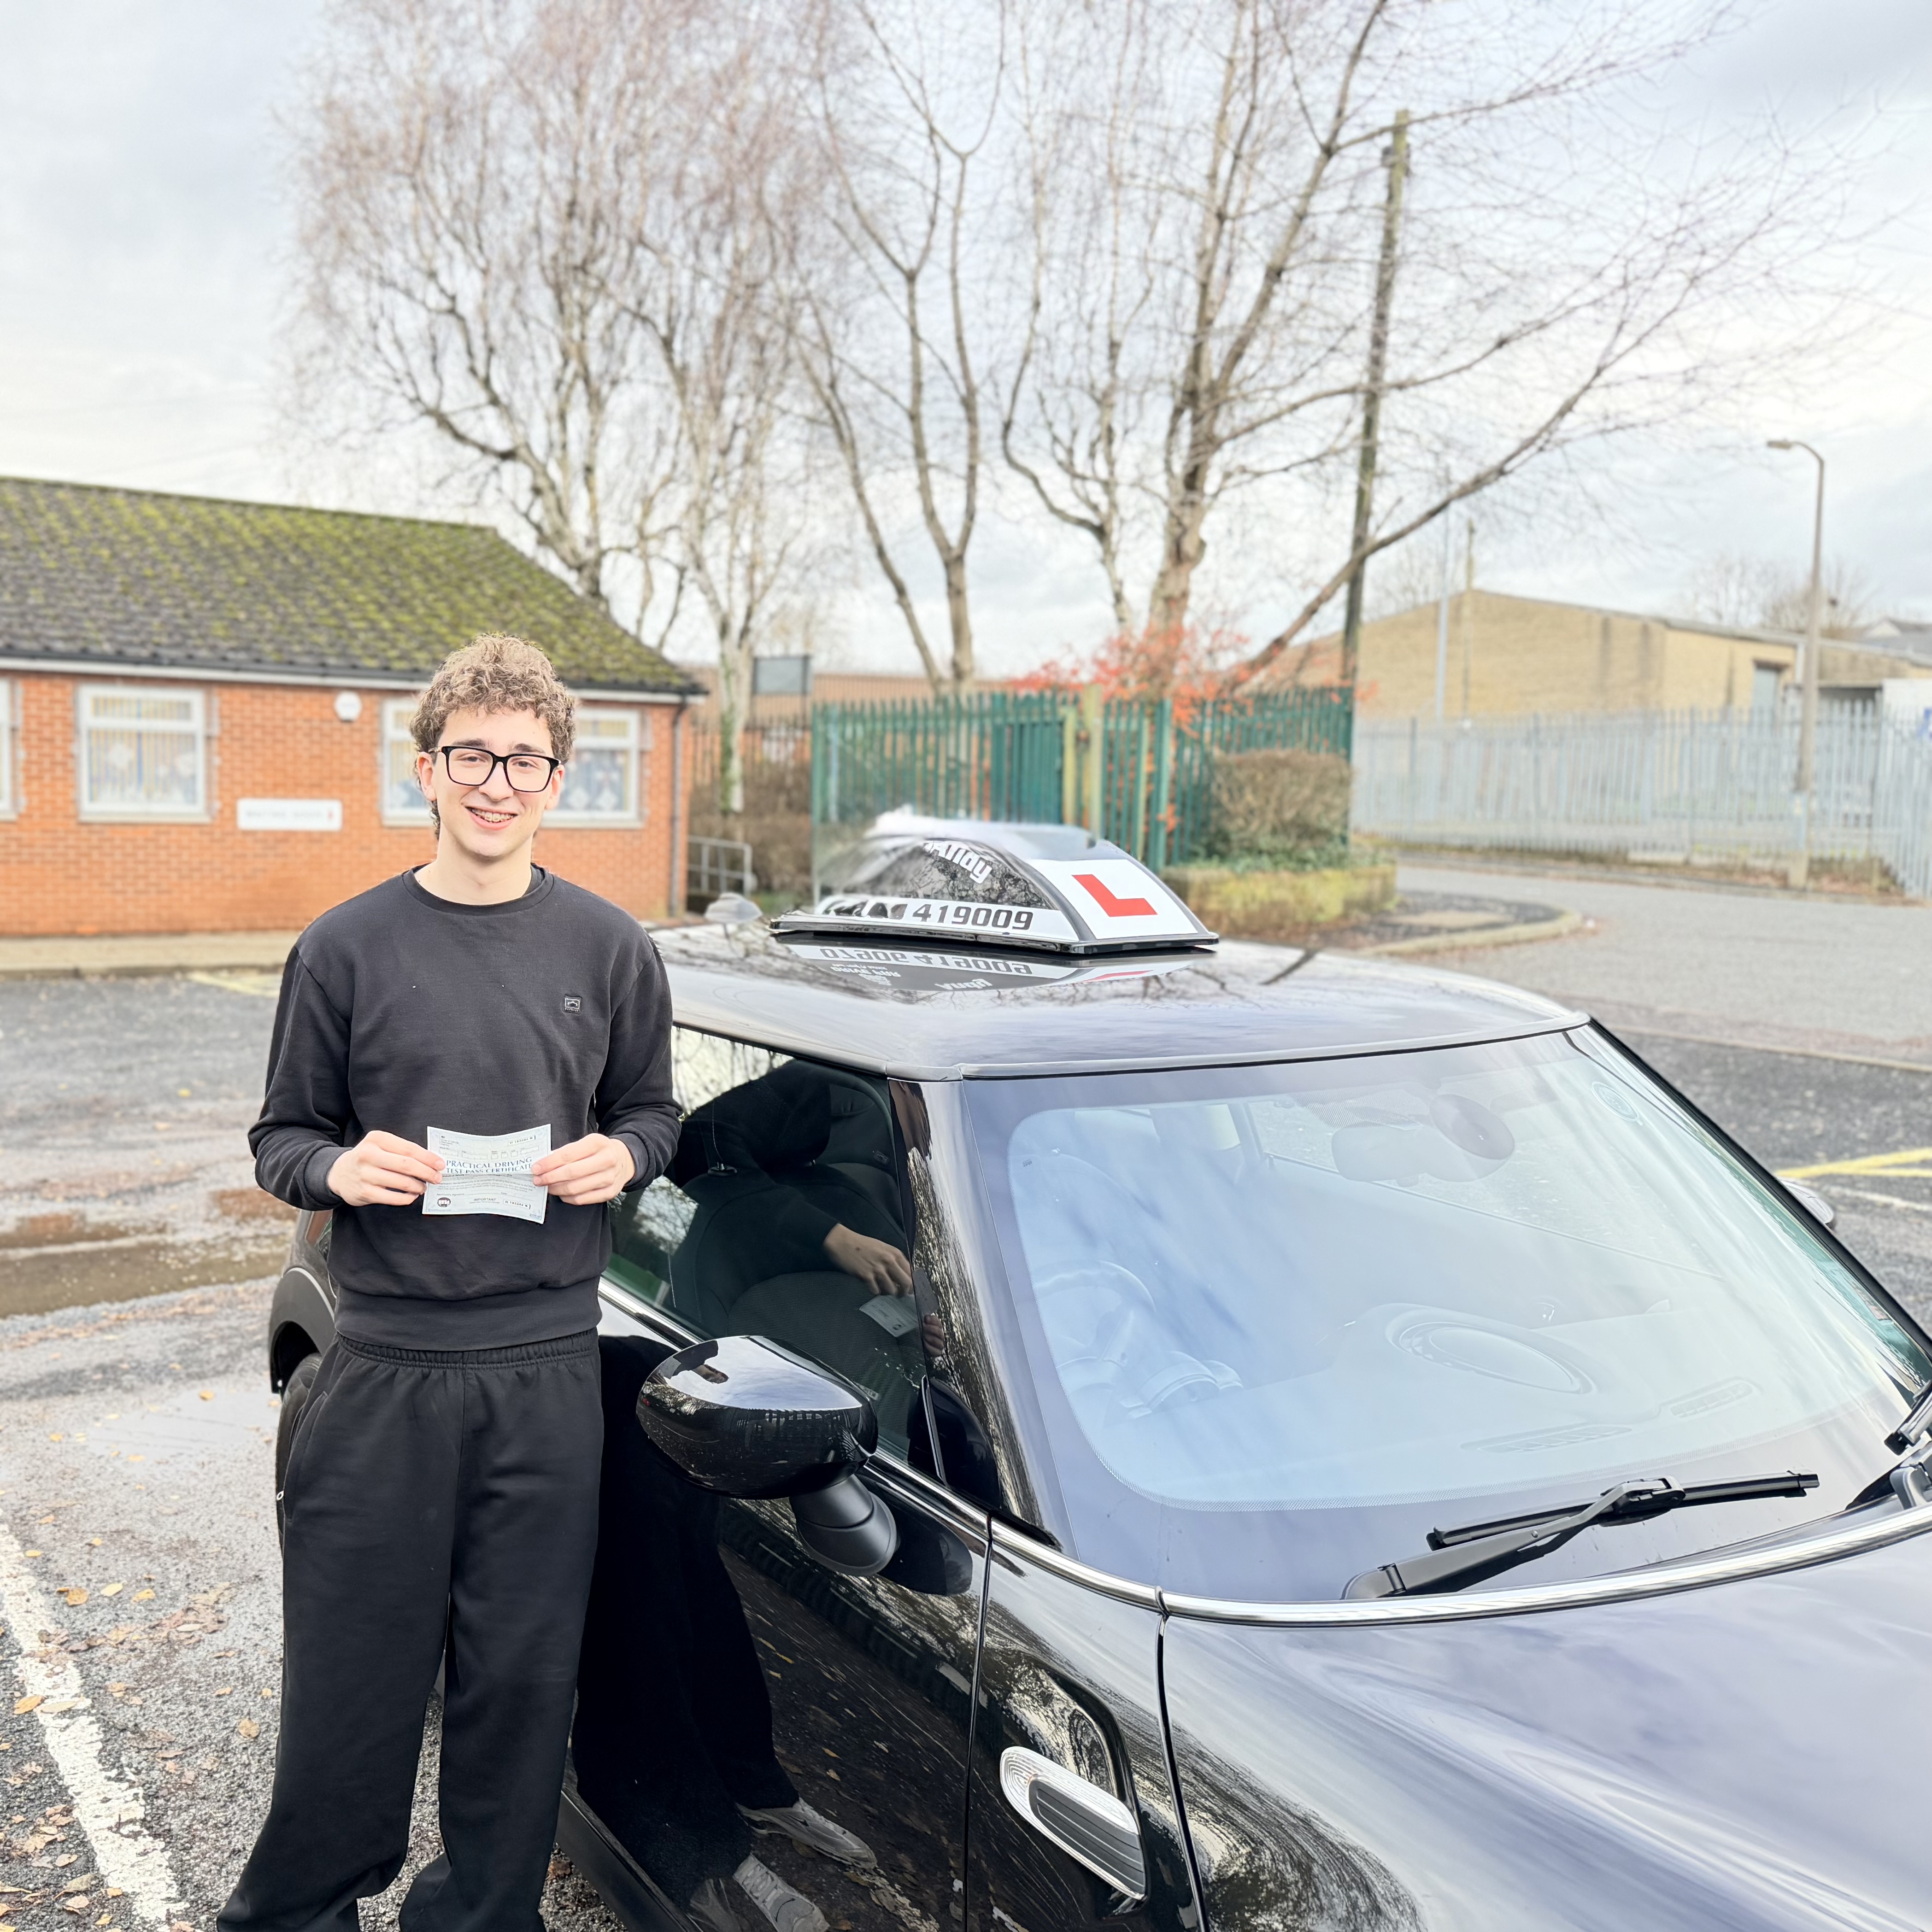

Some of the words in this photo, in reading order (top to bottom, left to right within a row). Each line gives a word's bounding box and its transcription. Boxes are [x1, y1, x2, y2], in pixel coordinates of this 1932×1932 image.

[1071, 873, 1158, 917] L
[912, 904, 1033, 930] 419009
[446, 1160, 491, 1169] PRACTICAL
[495, 1157, 532, 1167] DRIVING
[486, 1163, 532, 1173] CERTIFICATE
